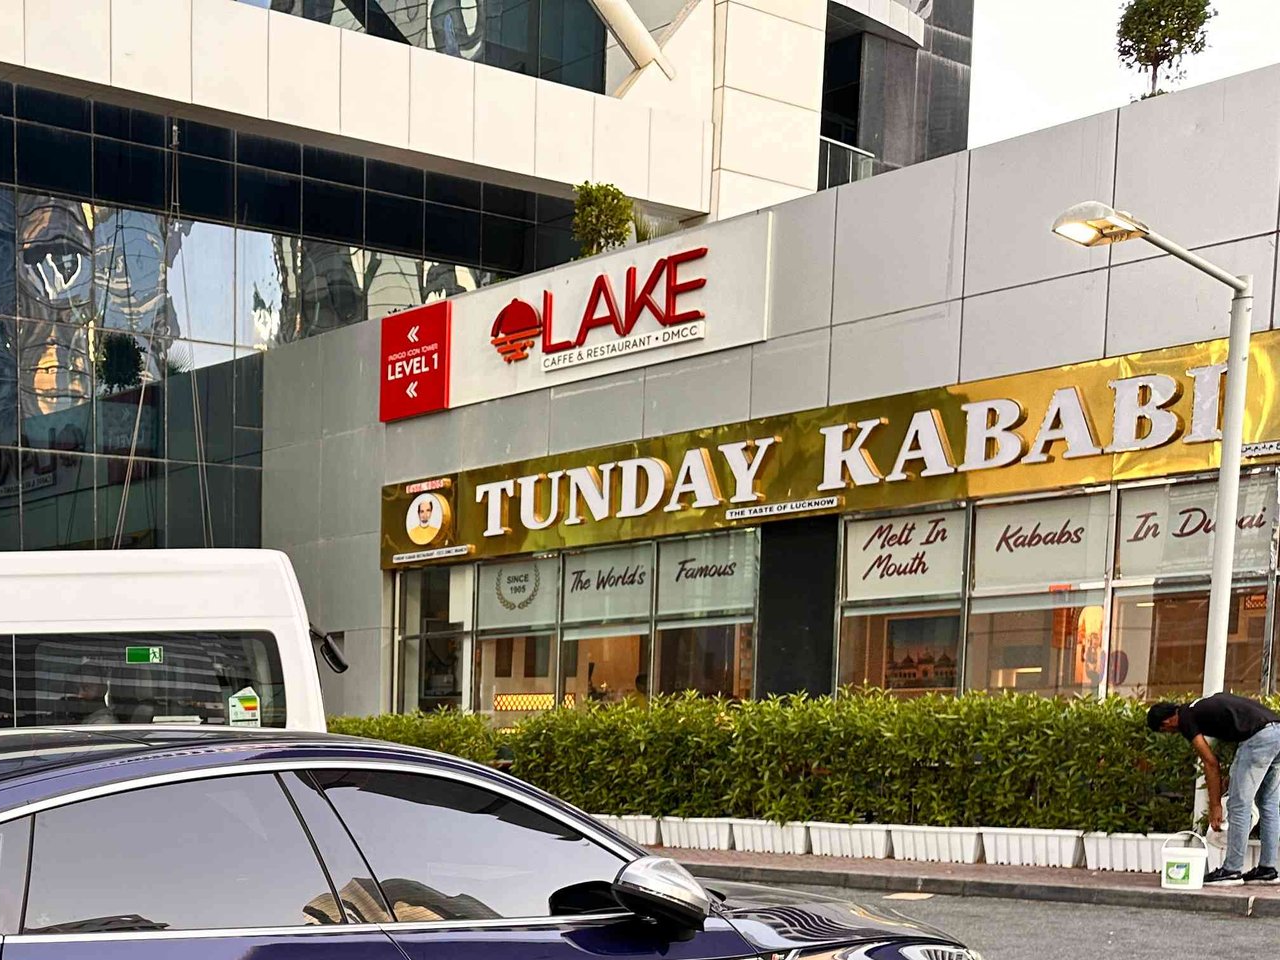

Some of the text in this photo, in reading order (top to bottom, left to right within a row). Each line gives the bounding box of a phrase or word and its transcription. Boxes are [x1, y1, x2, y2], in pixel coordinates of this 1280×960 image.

[542, 247, 708, 354] LAKE
[543, 325, 698, 369] CAFFE & RESTAURANT DMCC
[387, 352, 438, 380] LEVEL 1
[475, 364, 1228, 538] TUNDAY KABABI
[729, 498, 835, 518] THE TASTE OF LUCKNOW
[862, 517, 947, 551] Melt In
[995, 519, 1085, 553] Kababs
[1127, 507, 1266, 544] In Duai
[506, 573, 529, 585] SINCE
[570, 564, 646, 593] The World's
[675, 558, 737, 583] Famous
[862, 552, 929, 580] Mouth
